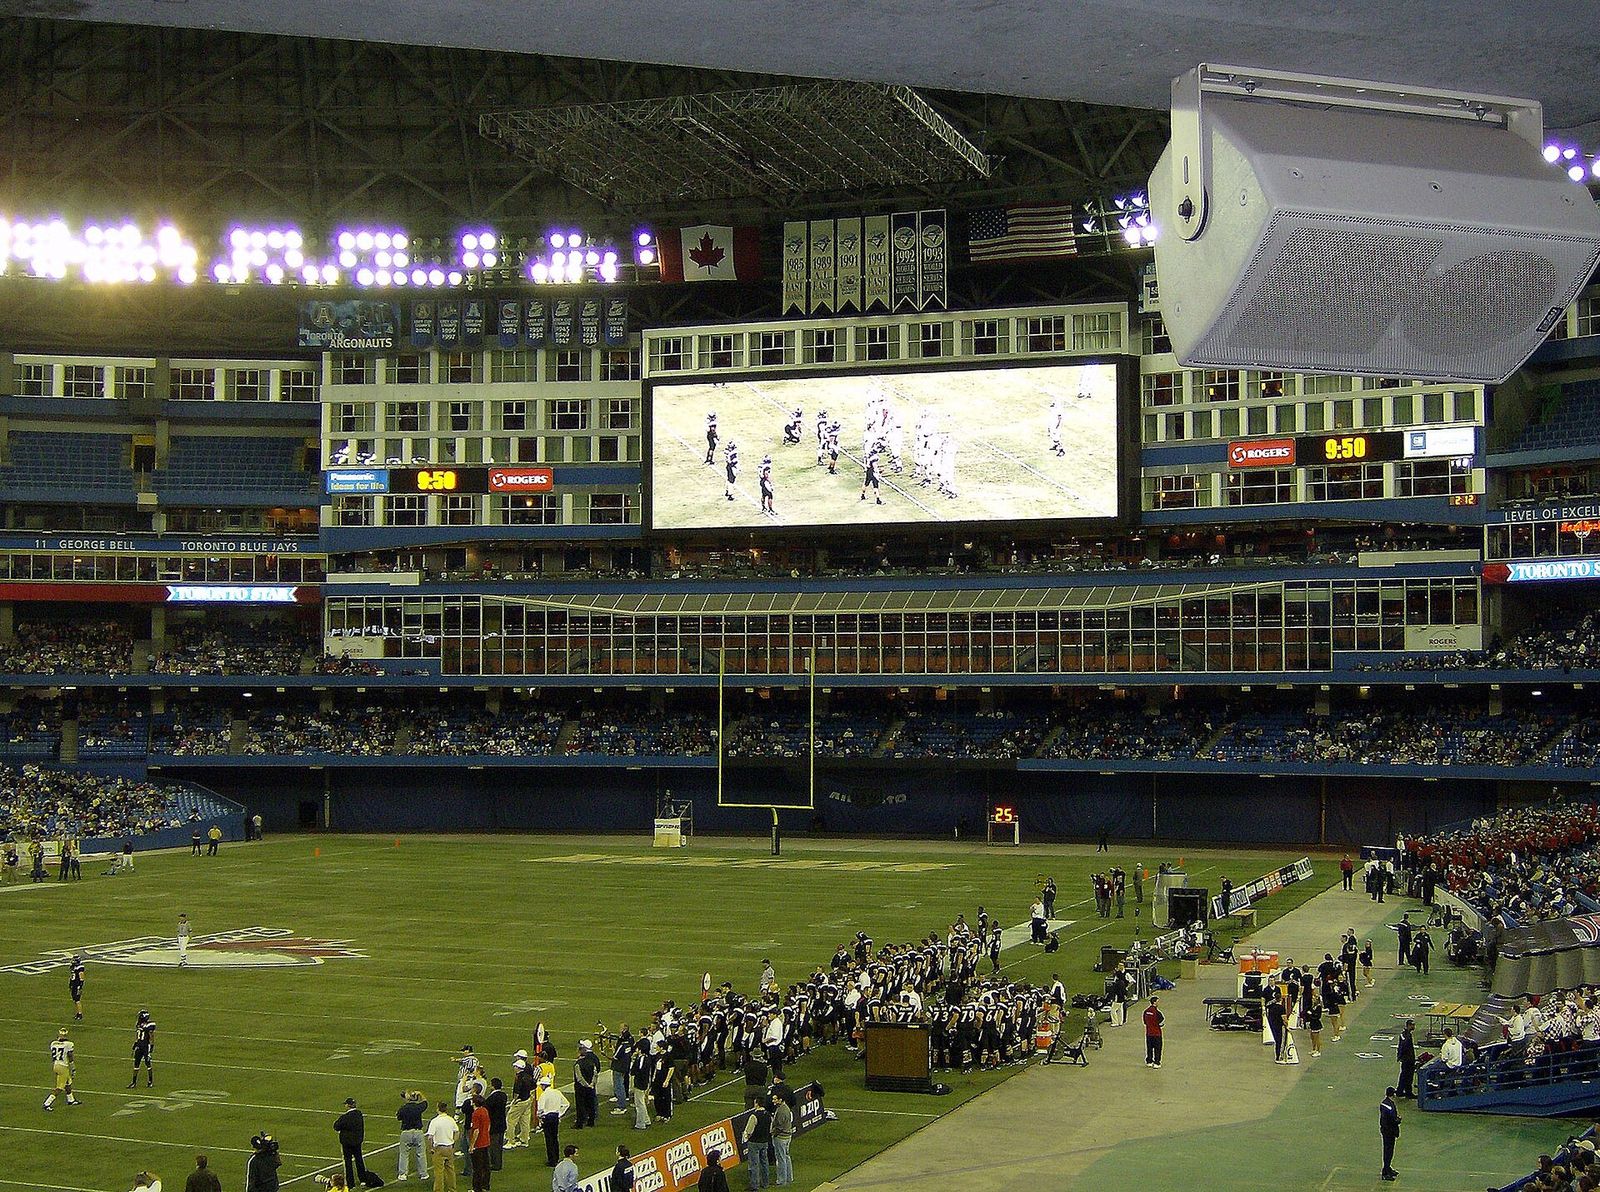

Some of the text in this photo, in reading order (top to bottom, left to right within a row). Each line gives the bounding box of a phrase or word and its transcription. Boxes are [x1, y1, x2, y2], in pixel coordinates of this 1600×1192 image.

[840, 254, 858, 267] 1991
[868, 252, 886, 265] 1991
[895, 250, 915, 264] 1992
[923, 247, 943, 262] 1993
[329, 338, 393, 348] ARGONAUTS
[1247, 447, 1291, 459] ROGERS
[1325, 437, 1366, 459] 9:50
[507, 475, 549, 484] ROGERS
[1504, 510, 1538, 521] LEVEL
[1542, 508, 1558, 519] OF
[35, 540, 47, 549] 11
[59, 540, 136, 550] GEORGE BELL
[181, 541, 298, 552] TORONTO BLUE JAYS
[1516, 562, 1591, 579] TORONTO
[995, 807, 1013, 822] 25
[897, 1011, 914, 1022] 77
[933, 1011, 949, 1022] 73
[961, 1010, 975, 1022] 79
[52, 1047, 64, 1061] 27
[701, 1127, 727, 1155] pizza
[666, 1140, 692, 1172] pizza
[673, 1155, 700, 1187] pizza
